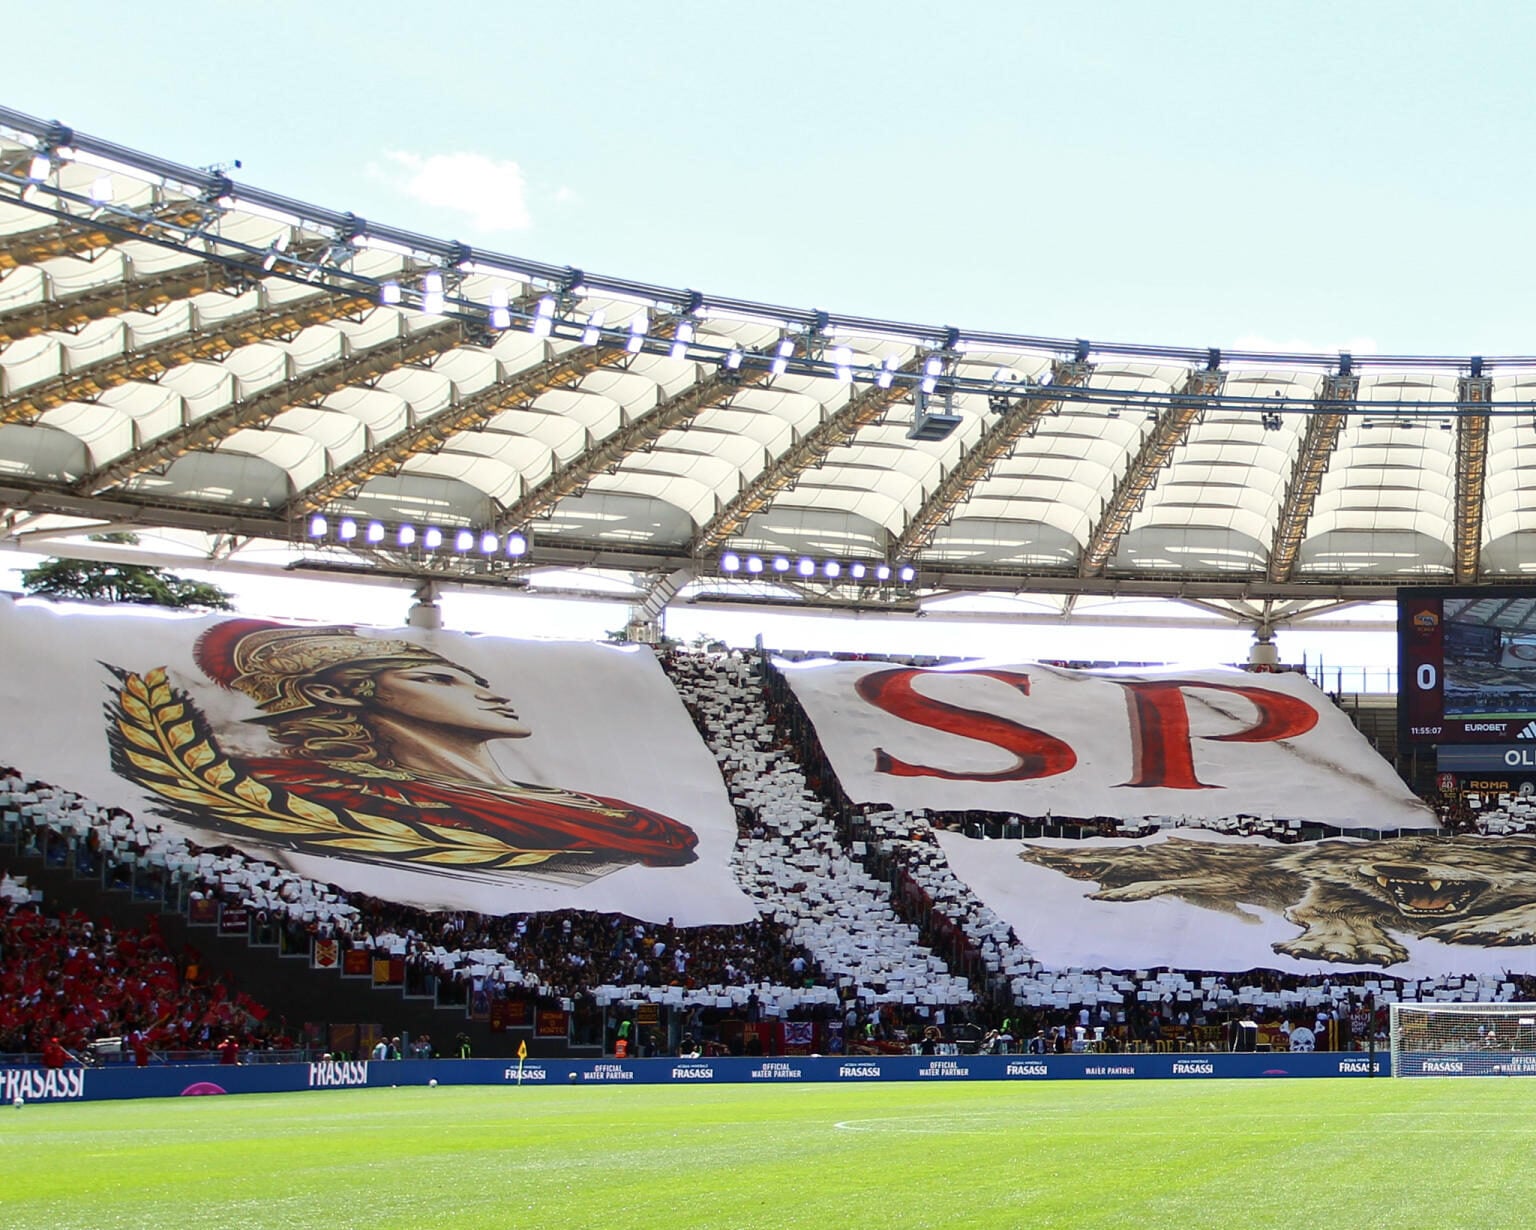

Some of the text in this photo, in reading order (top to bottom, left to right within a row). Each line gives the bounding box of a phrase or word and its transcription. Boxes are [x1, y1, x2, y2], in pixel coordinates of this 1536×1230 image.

[1416, 663, 1436, 690] 0
[853, 668, 1319, 790] SP
[1411, 727, 1442, 735] 11:55:07
[1464, 723, 1508, 731] EUROBET
[1470, 781, 1509, 789] ROMA
[930, 1061, 957, 1069] OFFICIAL
[1172, 1063, 1213, 1074] FRASASSI
[1422, 1062, 1463, 1072] FRASASSI
[1500, 1064, 1521, 1072] WATER
[505, 1069, 546, 1080] FRASASSI
[672, 1068, 713, 1078] FRASASSI
[752, 1070, 801, 1078] WATER PARTNER
[839, 1067, 880, 1077] FRASASSI
[919, 1068, 969, 1076] WATER PARTNER
[1006, 1065, 1047, 1075] FRASASSI
[584, 1071, 634, 1080] WATER PARTNER
